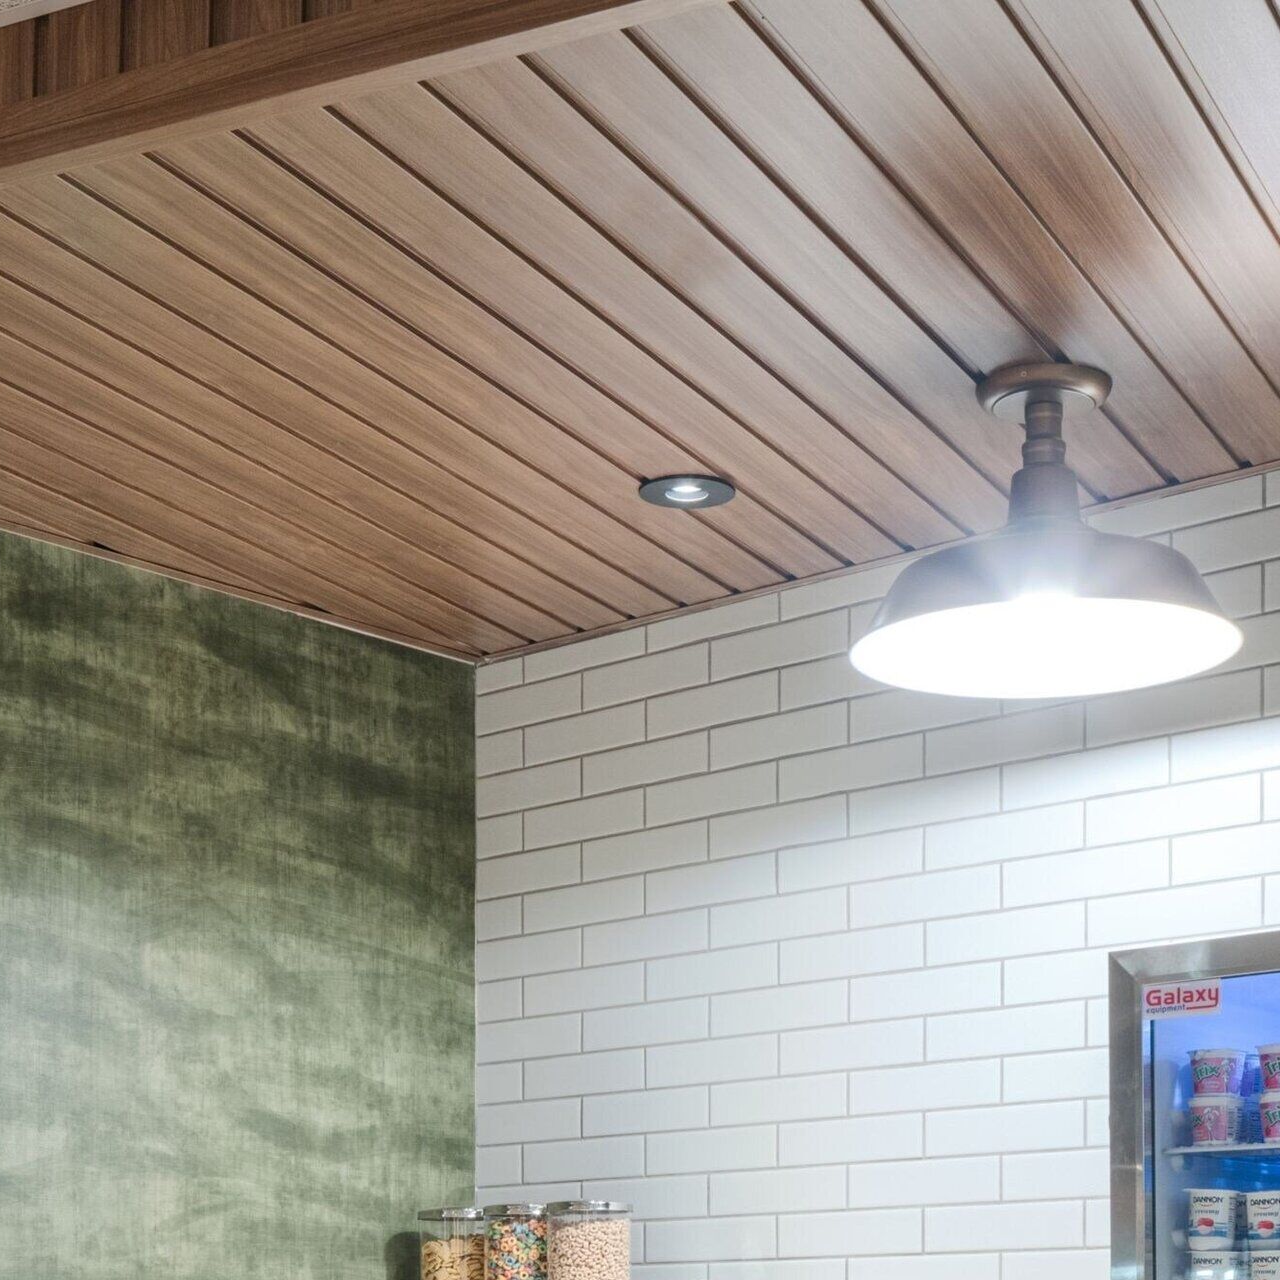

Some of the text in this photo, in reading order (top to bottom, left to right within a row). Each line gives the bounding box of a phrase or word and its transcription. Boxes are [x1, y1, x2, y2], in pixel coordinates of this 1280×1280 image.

[1146, 986, 1219, 1009] Galaxy
[1146, 1004, 1186, 1014] equipment
[1193, 1196, 1224, 1204] DANNON
